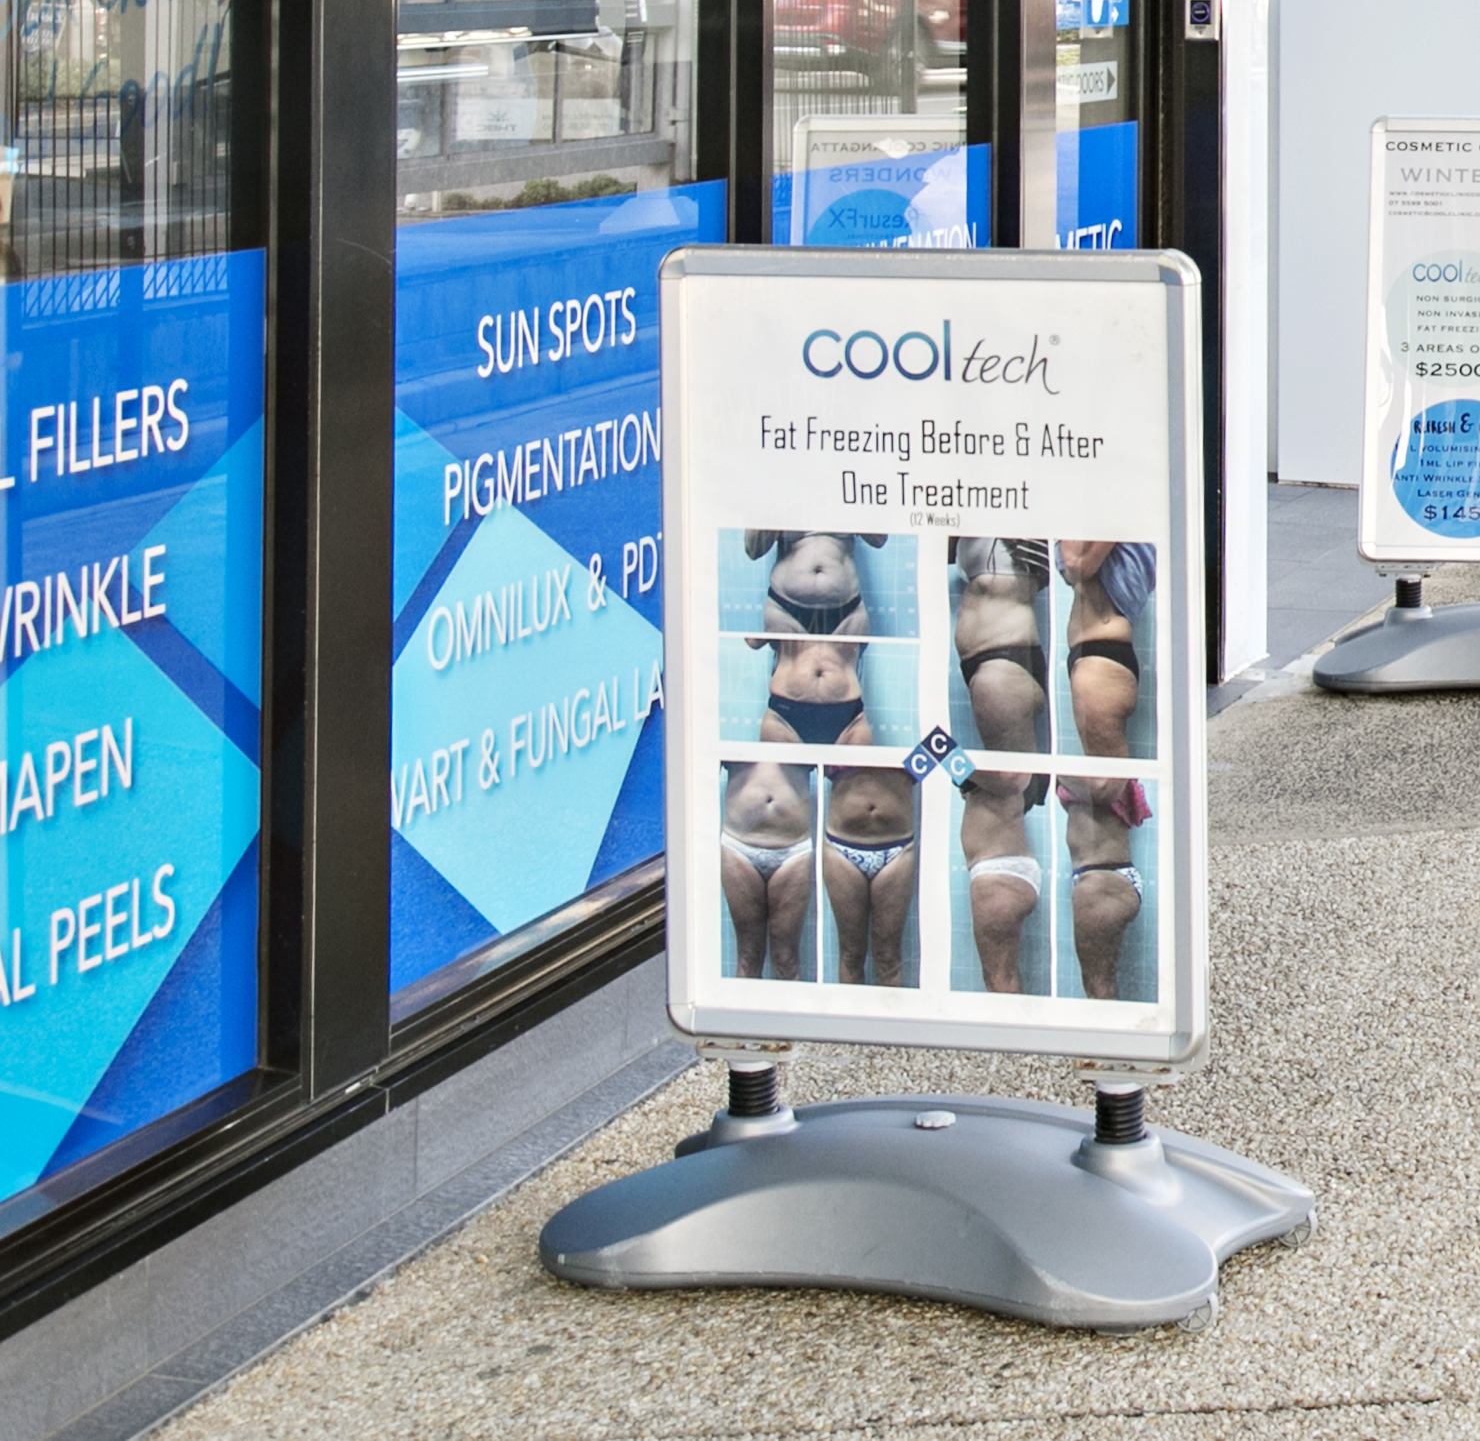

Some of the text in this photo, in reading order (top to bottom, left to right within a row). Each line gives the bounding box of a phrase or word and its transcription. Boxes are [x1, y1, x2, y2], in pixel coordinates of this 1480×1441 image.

[1386, 141, 1472, 152] COSMETIC
[1412, 259, 1462, 283] cool
[1416, 294, 1439, 302] NON
[477, 287, 637, 379] SUN SPOTS
[802, 318, 951, 383] cool
[1400, 342, 1410, 352] 3
[1416, 344, 1464, 353] AREAS
[30, 377, 190, 483] FILLERS
[761, 414, 1104, 461] Fat Freezing Before & After
[1460, 412, 1474, 434] &
[443, 407, 663, 527] PIGMENTATION
[1420, 459, 1441, 468] 1ML
[842, 470, 1029, 511] One Treatment
[910, 512, 960, 529] (12 Weeks)
[427, 567, 571, 672] OMNILUX
[587, 553, 606, 611] &
[477, 728, 499, 789] &
[511, 690, 625, 772] FUNGAL
[50, 864, 176, 981] PEELS
